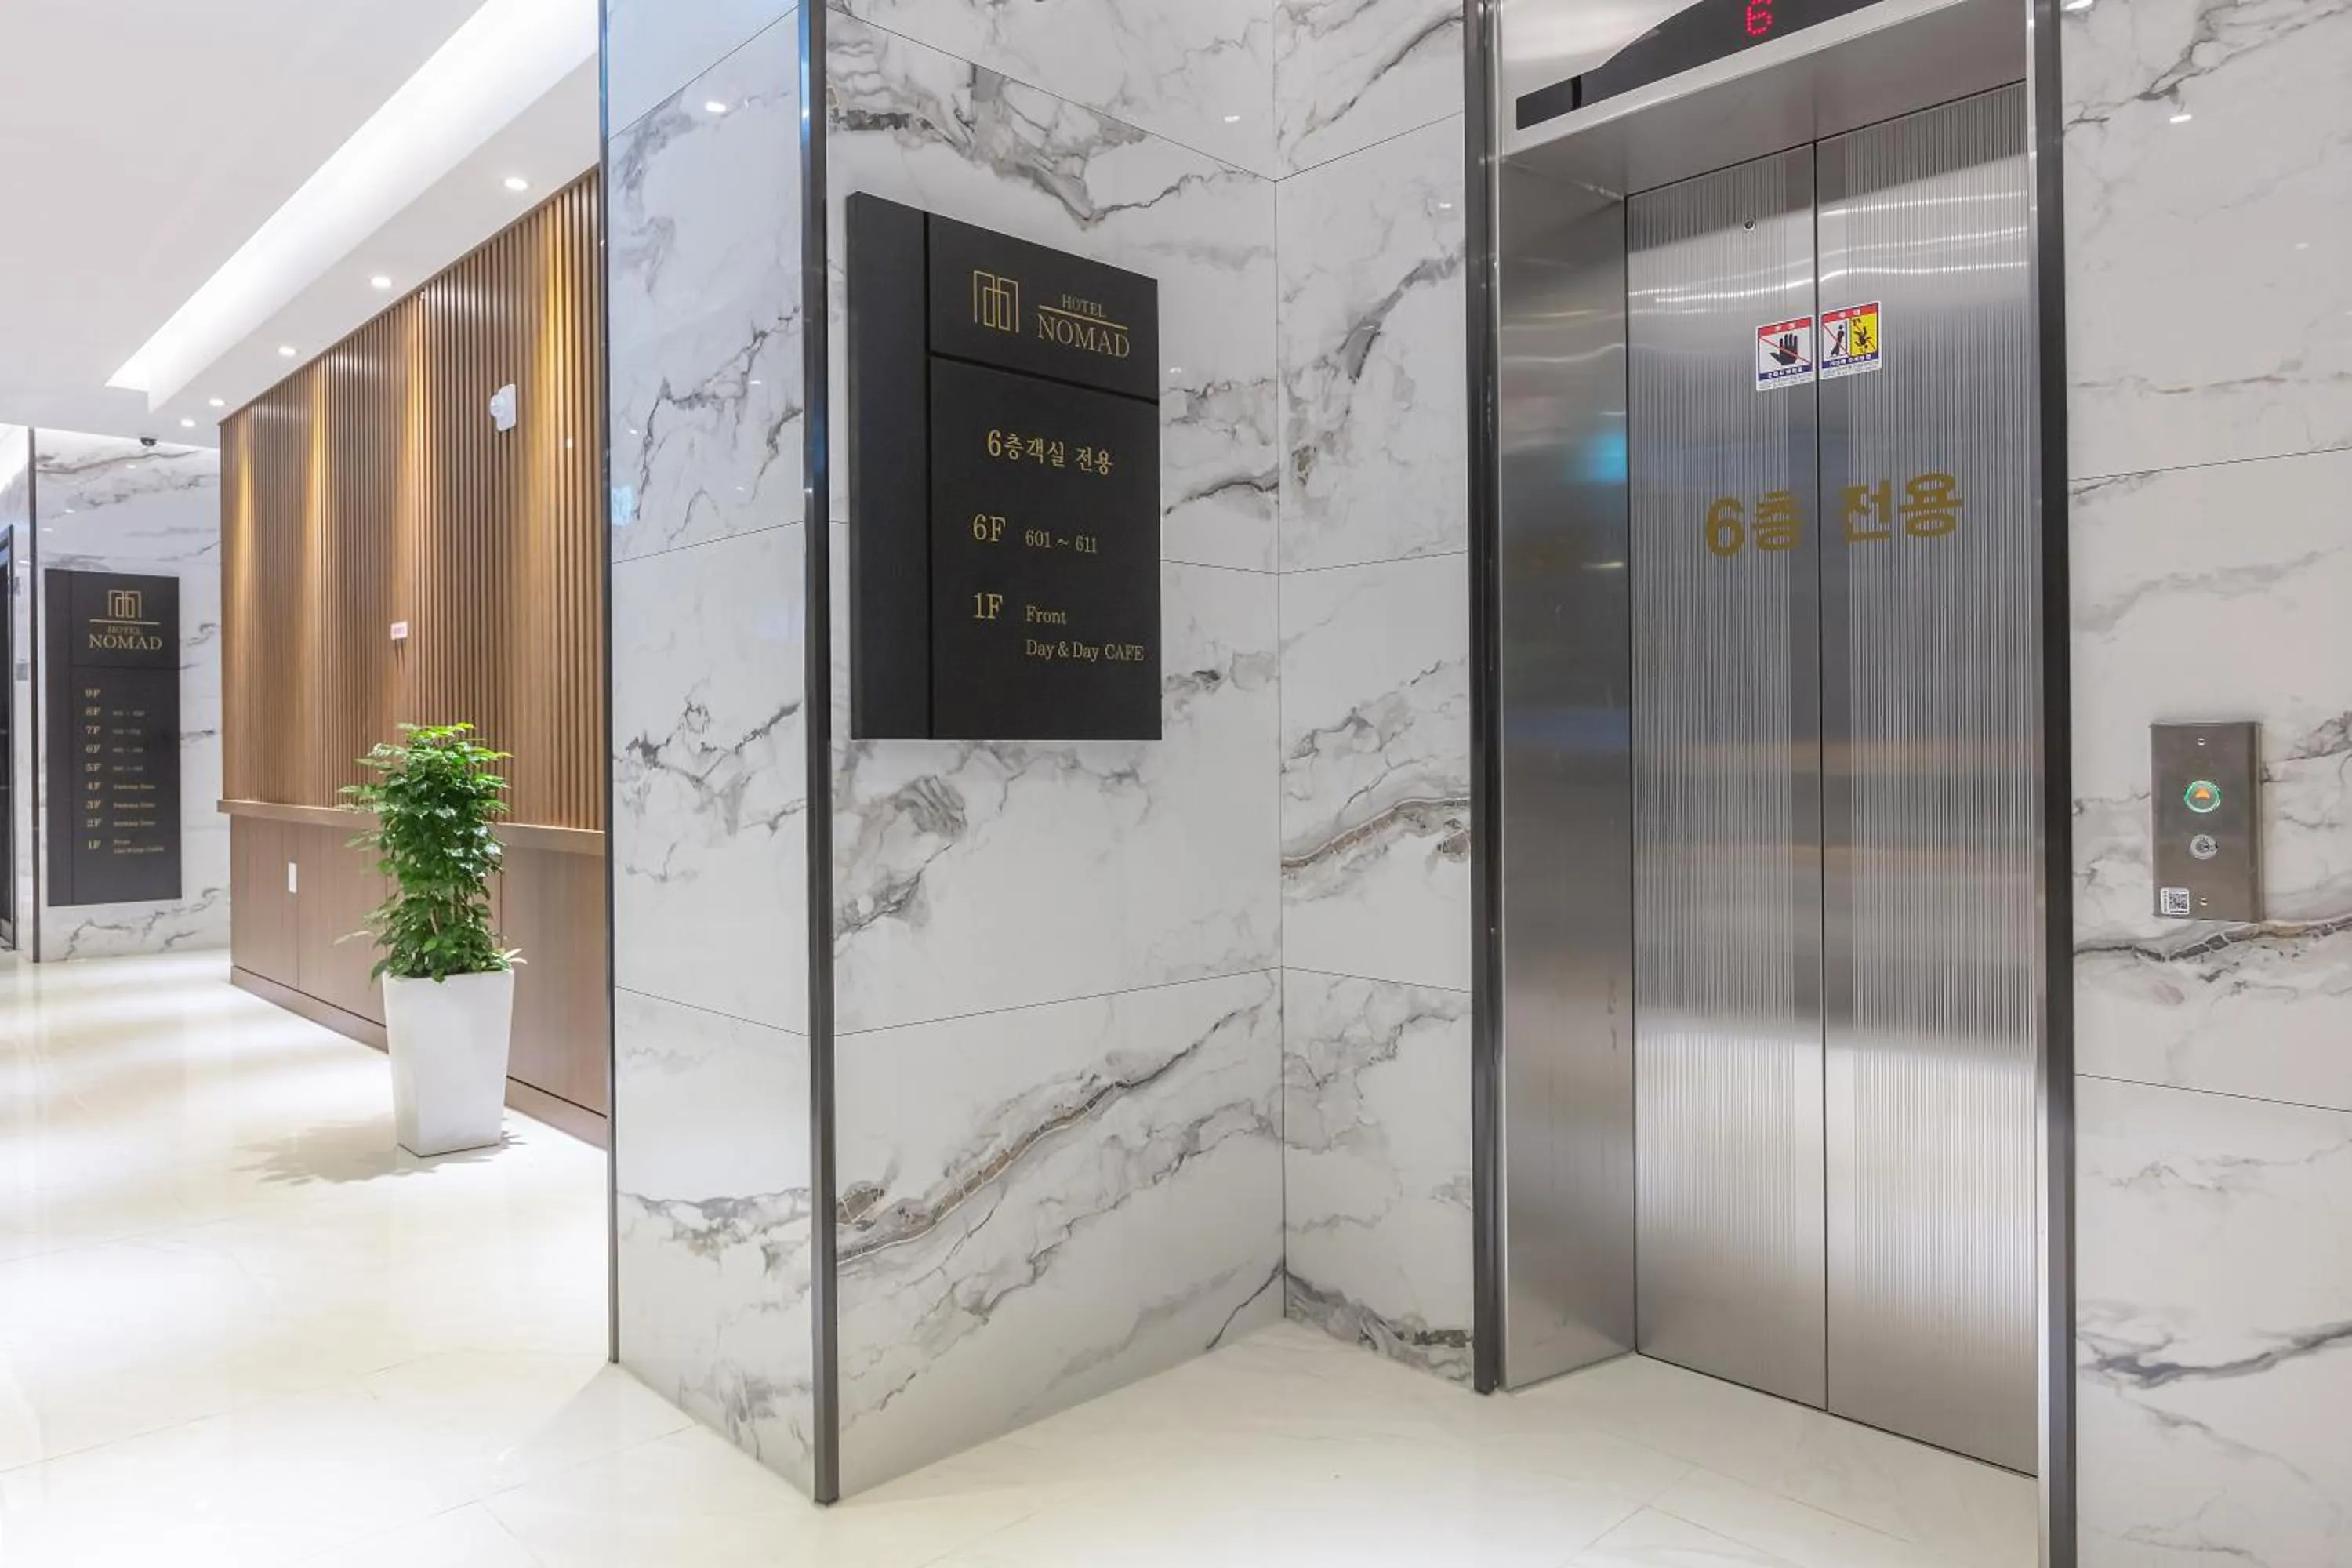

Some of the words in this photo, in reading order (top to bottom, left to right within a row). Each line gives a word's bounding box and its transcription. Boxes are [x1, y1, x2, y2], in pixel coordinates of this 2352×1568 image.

[1745, 0, 1773, 37] 6
[1062, 294, 1107, 318] HOTEL
[1037, 313, 1130, 358] NOMAD
[987, 429, 1065, 468] 6층객실
[1075, 446, 1113, 475] 전용
[1707, 489, 1801, 557] 6층
[1840, 472, 1963, 543] 전용
[973, 514, 1007, 542] 6F
[1025, 529, 1051, 548] 601
[1075, 535, 1097, 554] 611
[973, 593, 1003, 619] 1F
[1025, 604, 1067, 625] Front
[89, 633, 162, 651] NOMAD
[1025, 639, 1054, 660] Day
[1058, 641, 1069, 658] &
[1073, 641, 1100, 662] Day
[1105, 644, 1144, 662] CAFE
